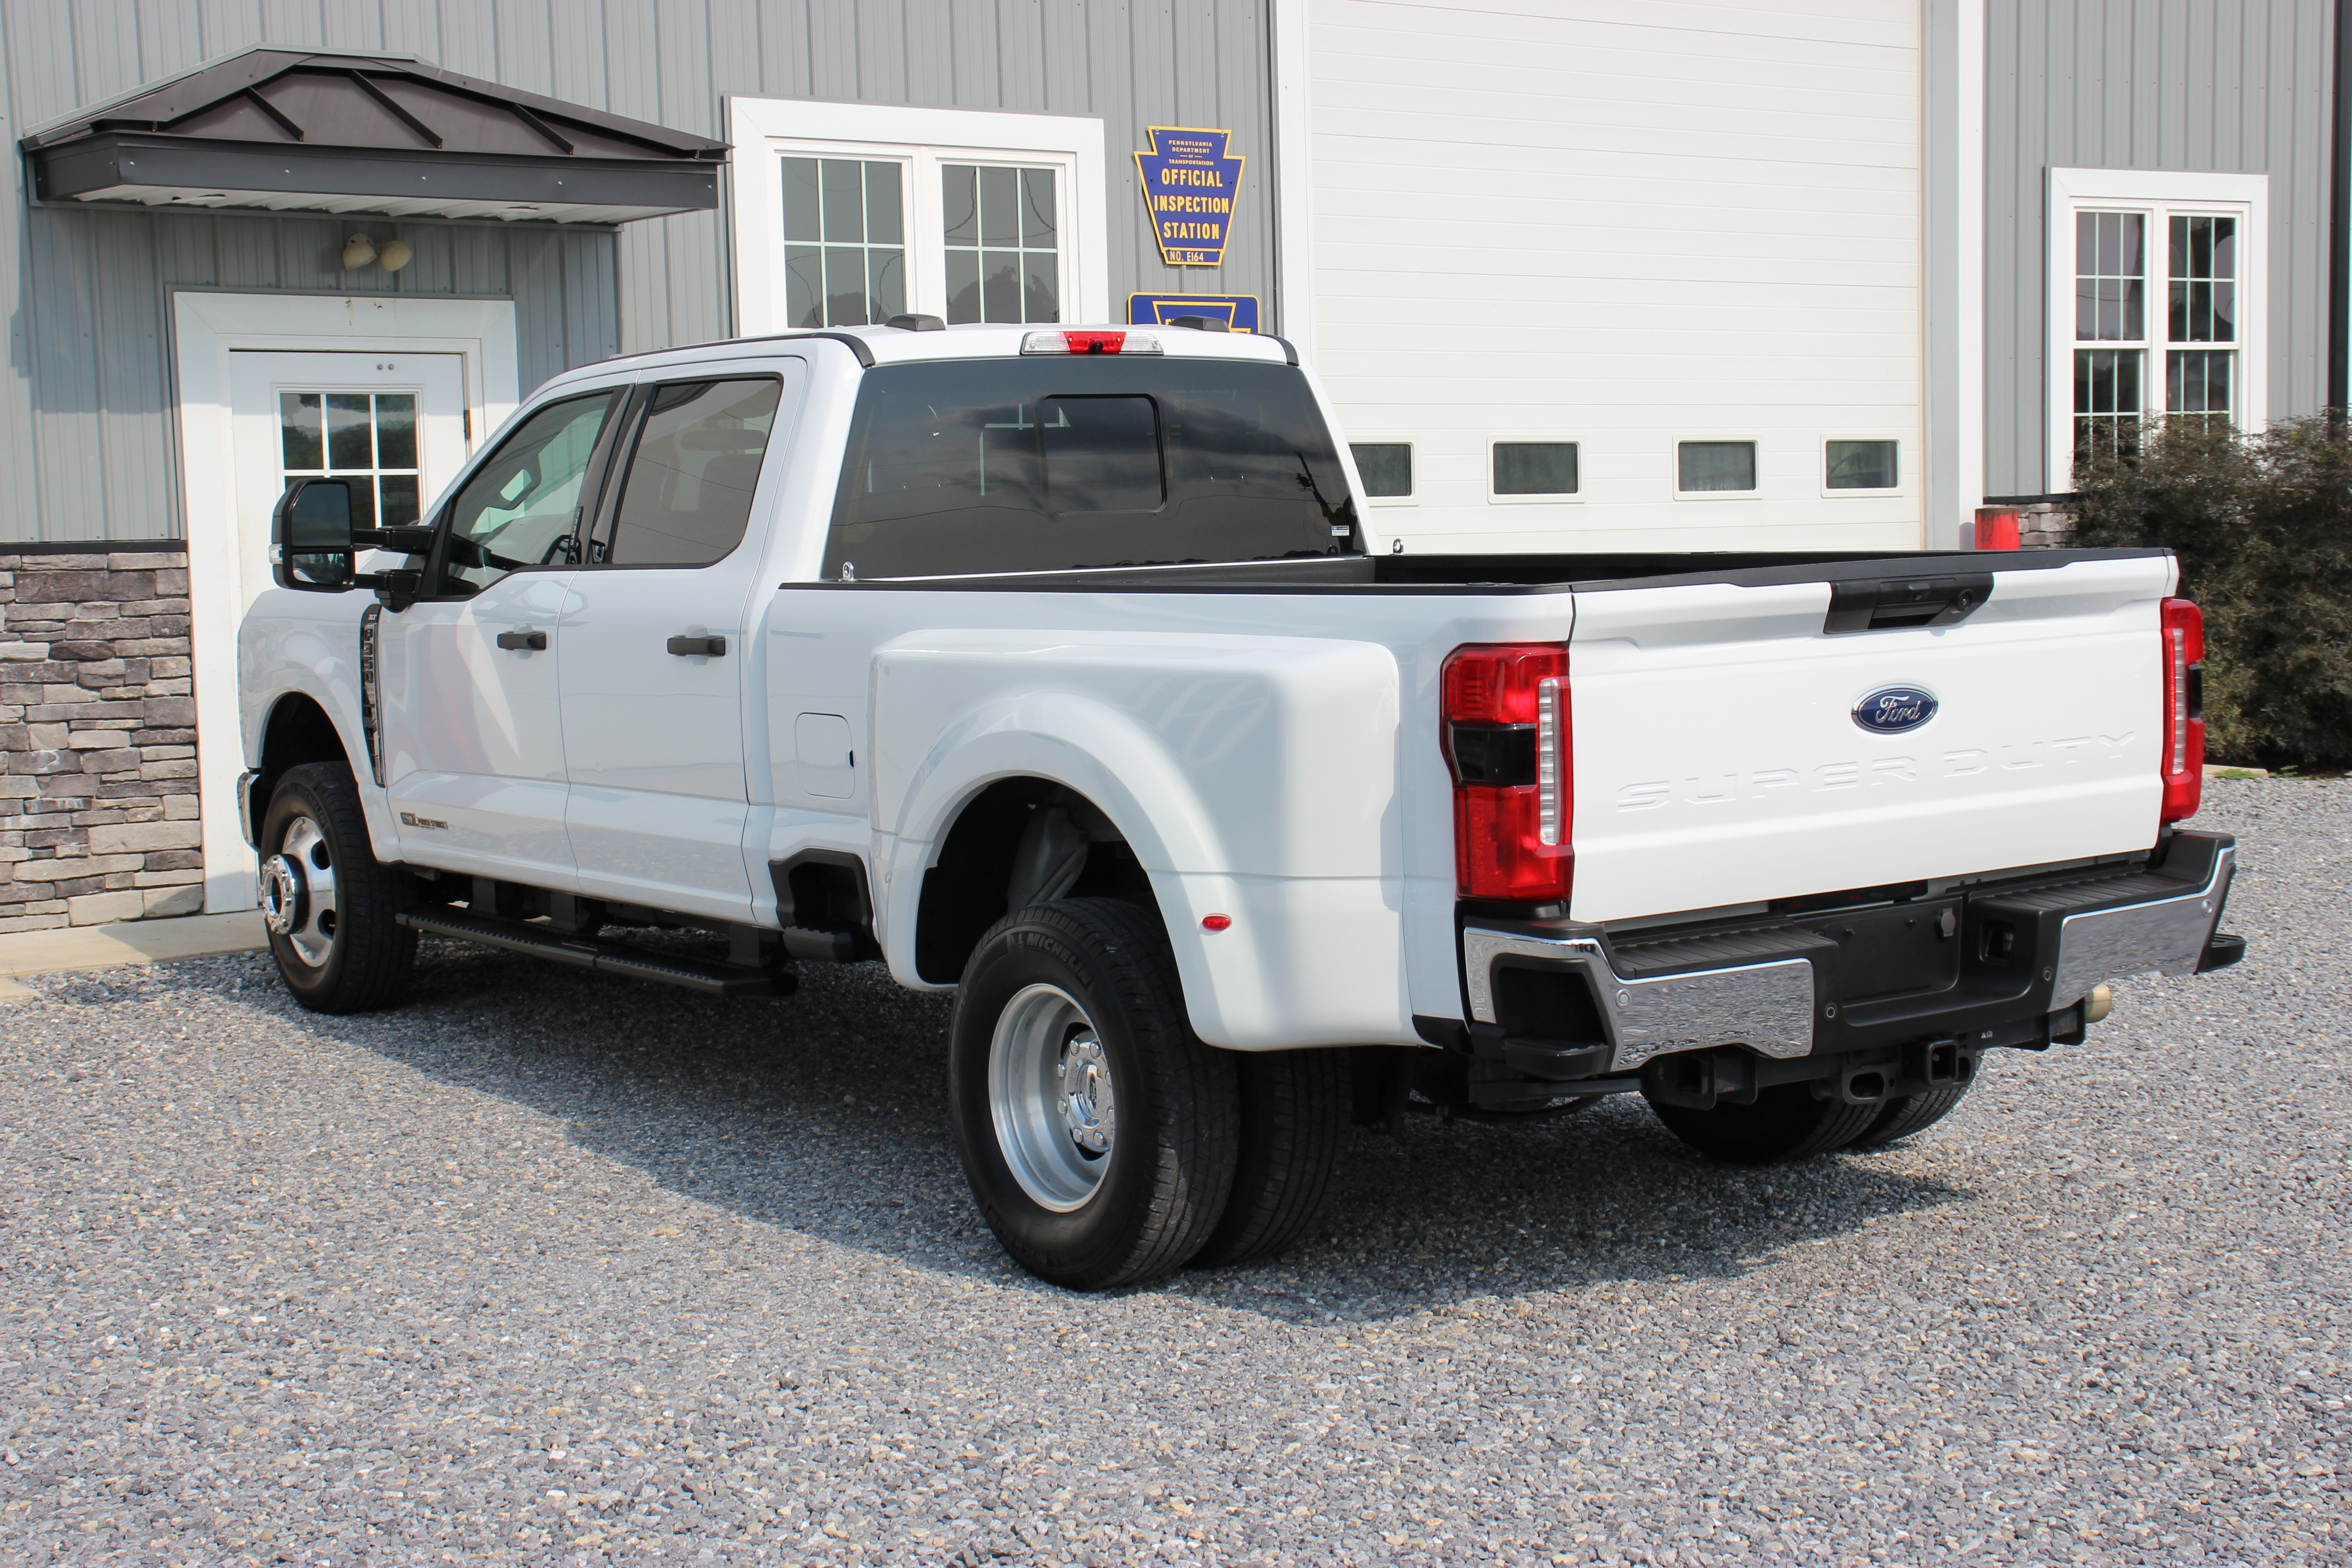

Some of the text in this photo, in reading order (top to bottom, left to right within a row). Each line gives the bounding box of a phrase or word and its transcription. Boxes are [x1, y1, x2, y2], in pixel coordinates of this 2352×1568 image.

[1161, 167, 1223, 187] OFFICIAL
[1153, 195, 1230, 214] INSPECTION
[1163, 221, 1220, 240] STATION
[1169, 250, 1184, 262] NO.
[1875, 696, 1921, 724] Ford
[1617, 730, 2136, 813] SUPER DUTY
[1026, 932, 1093, 985] MICHELIN
